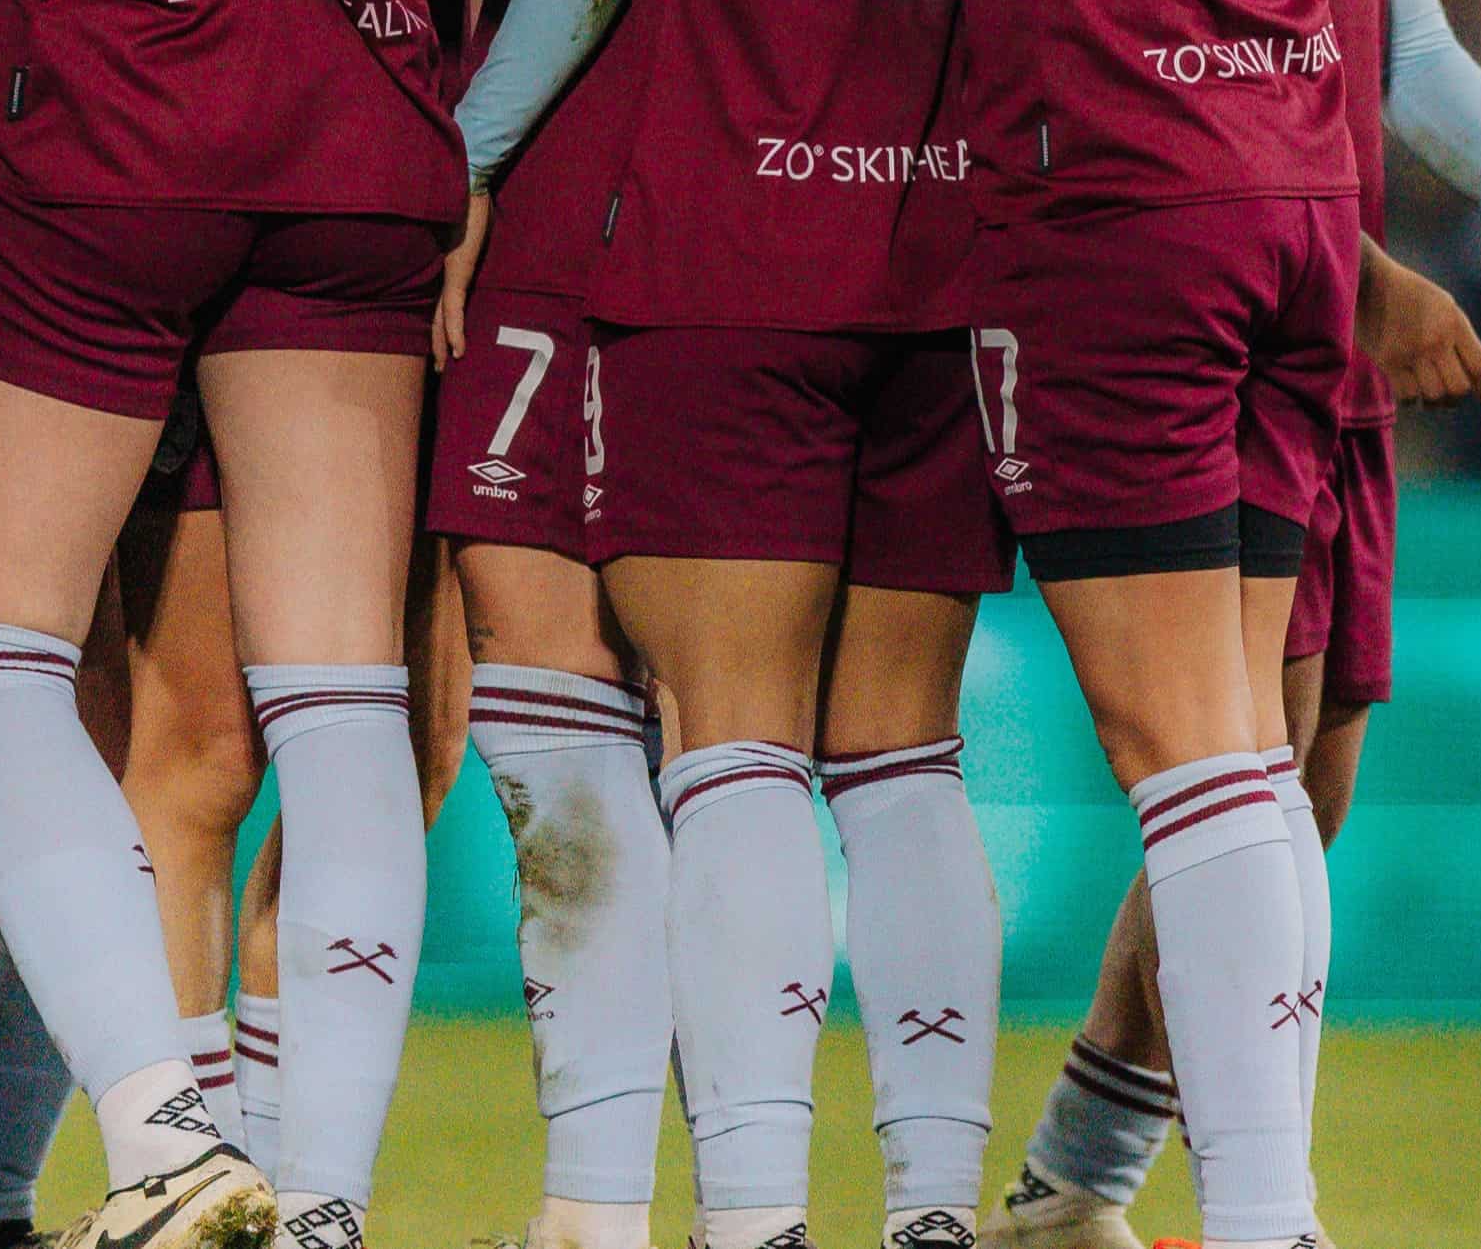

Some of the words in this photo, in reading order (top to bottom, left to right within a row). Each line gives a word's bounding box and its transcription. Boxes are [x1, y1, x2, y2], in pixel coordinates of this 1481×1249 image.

[1212, 36, 1276, 79] SKIN
[487, 325, 556, 456] 7
[472, 483, 519, 502] umbro
